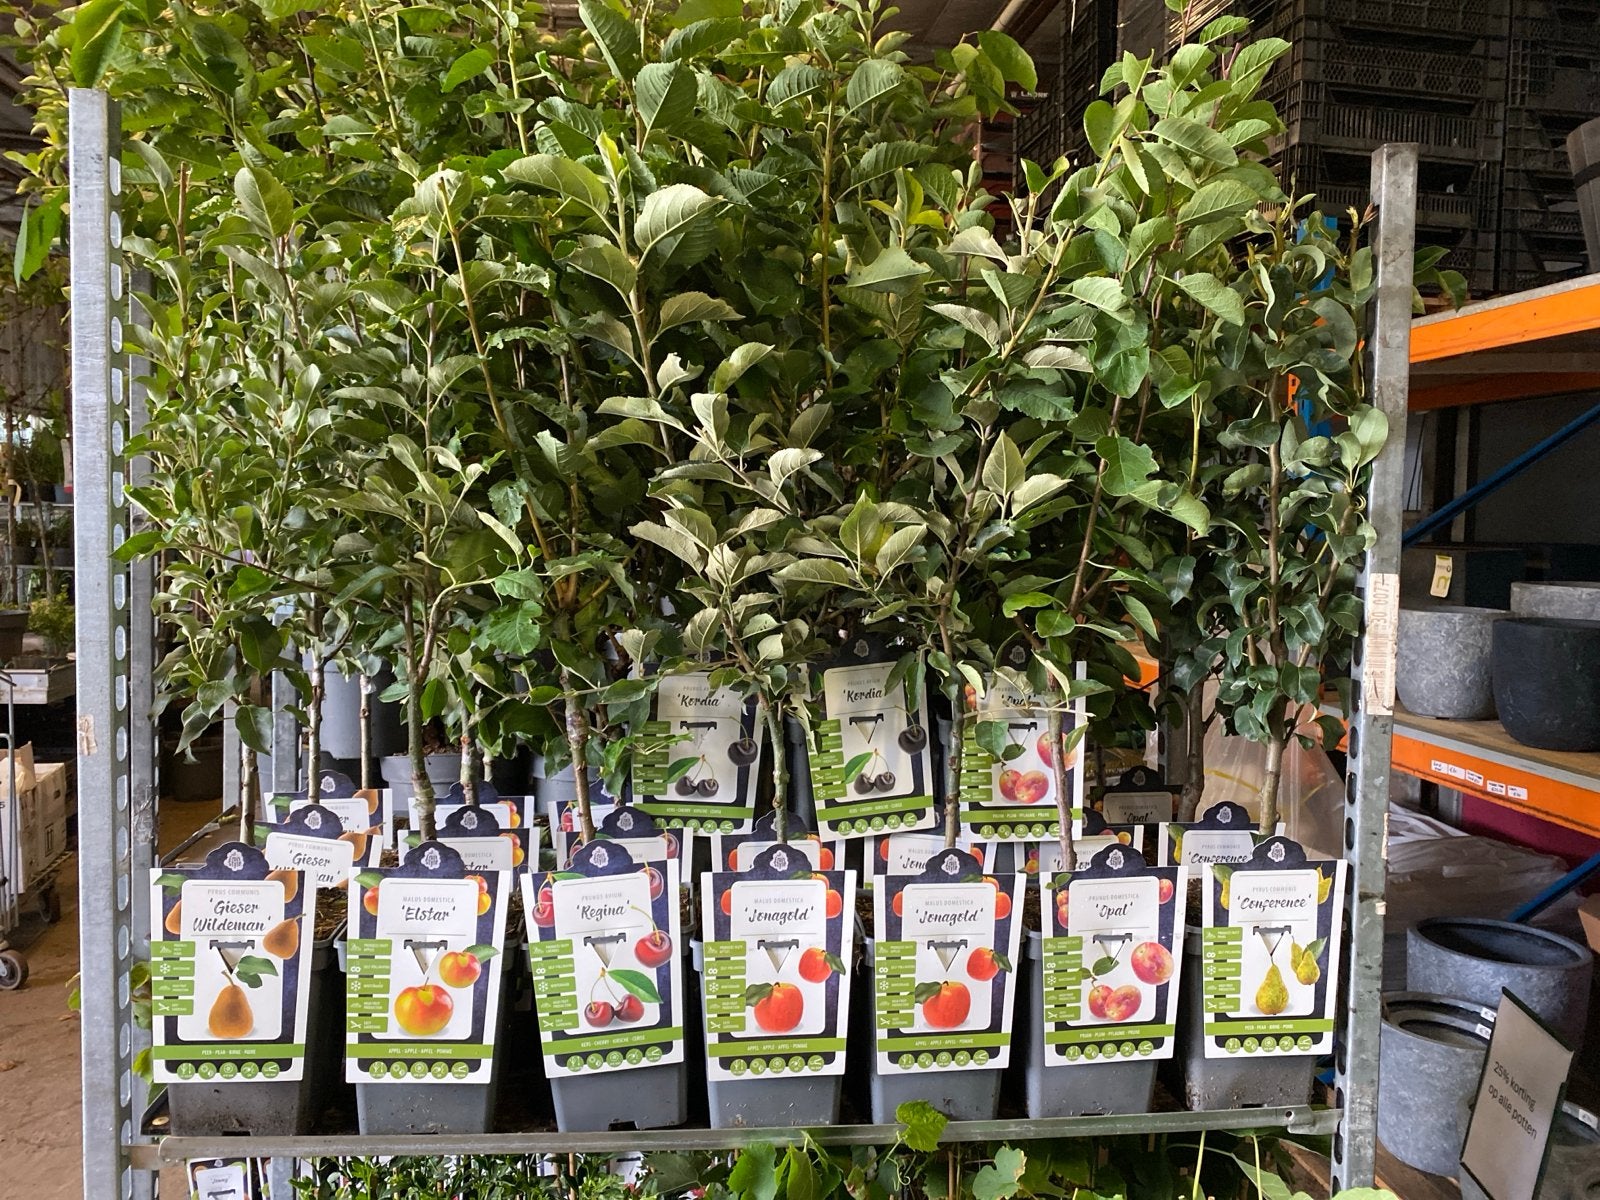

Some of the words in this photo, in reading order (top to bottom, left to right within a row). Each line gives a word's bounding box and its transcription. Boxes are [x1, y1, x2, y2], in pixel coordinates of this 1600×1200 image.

[290, 850, 330, 866] 'Gieser
[210, 898, 259, 915] 'Gieser
[577, 900, 630, 922] 'Regina'
[1096, 902, 1133, 920] 'Opal'
[1237, 894, 1311, 912] 'Conference'
[402, 905, 456, 921] 'Elstar'
[745, 906, 814, 926] 'Jonagold'
[916, 908, 983, 926] 'Jonagold'
[193, 916, 271, 932] Wildeman'
[1493, 1061, 1510, 1084] 25%
[1510, 1077, 1536, 1112] korting
[1488, 1084, 1498, 1098] op
[1499, 1094, 1512, 1113] alle
[1512, 1110, 1537, 1139] potten
